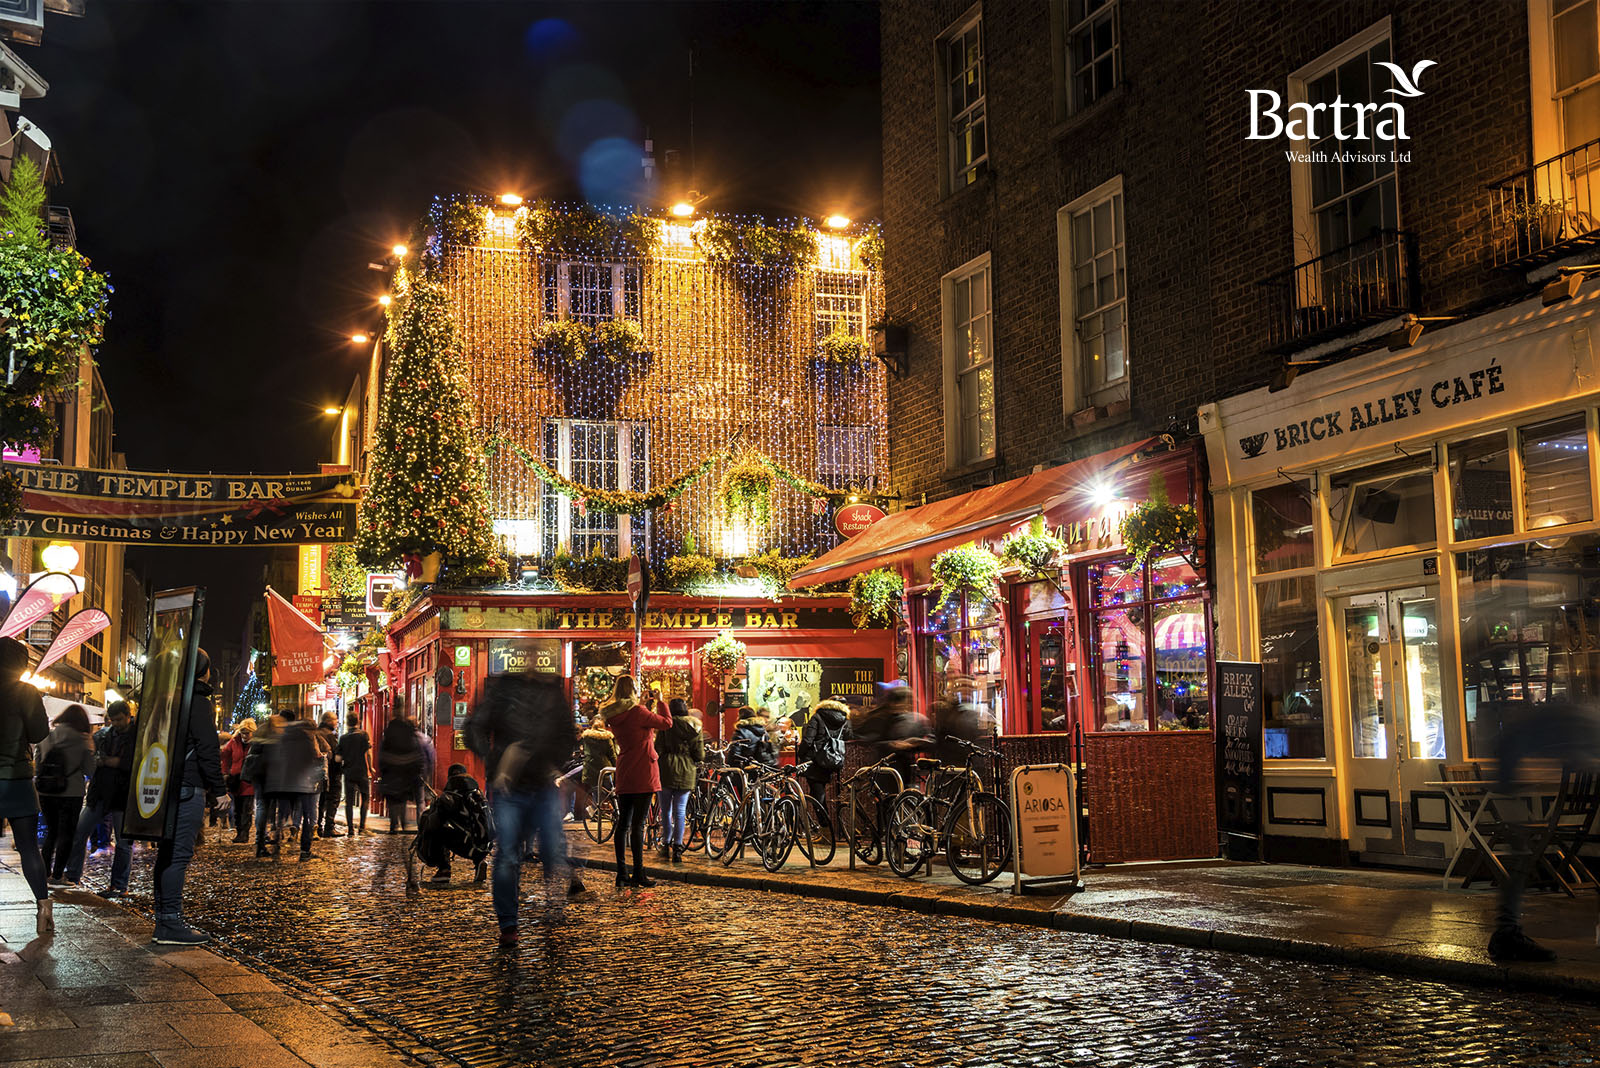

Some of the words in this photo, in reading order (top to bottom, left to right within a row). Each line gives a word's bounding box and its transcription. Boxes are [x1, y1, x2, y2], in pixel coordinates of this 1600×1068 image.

[1274, 411, 1343, 451] BRICK
[1349, 388, 1422, 432] ALLEY
[1431, 358, 1505, 408] CAFÉ
[15, 467, 79, 491] THE
[97, 475, 212, 499] TEMPLE
[228, 481, 285, 499] BAR
[295, 511, 327, 520] Wishes
[328, 510, 343, 519] All
[851, 509, 872, 522] Shack
[1496, 511, 1513, 520] CAF
[41, 517, 152, 540] Christmas
[160, 526, 178, 540] &
[182, 526, 248, 545] Happy
[253, 525, 296, 541] New
[301, 523, 345, 538] Year
[13, 597, 46, 623] CLOUD
[556, 612, 614, 628] THE
[624, 612, 732, 628] TEMPLE
[745, 612, 798, 628] BAR
[640, 645, 688, 657] Traditional
[281, 656, 321, 667] TEMPLE
[499, 653, 551, 670] TOBCO
[664, 656, 690, 666] Music
[291, 665, 313, 673] BAR
[773, 664, 820, 673] TEMPLE
[786, 673, 809, 682] BAR
[854, 670, 874, 682] THE
[1223, 672, 1254, 687] BRICK
[831, 683, 874, 695] EMPEROR
[1223, 685, 1255, 699] ALLEY
[1023, 797, 1065, 813] ARIOSA
